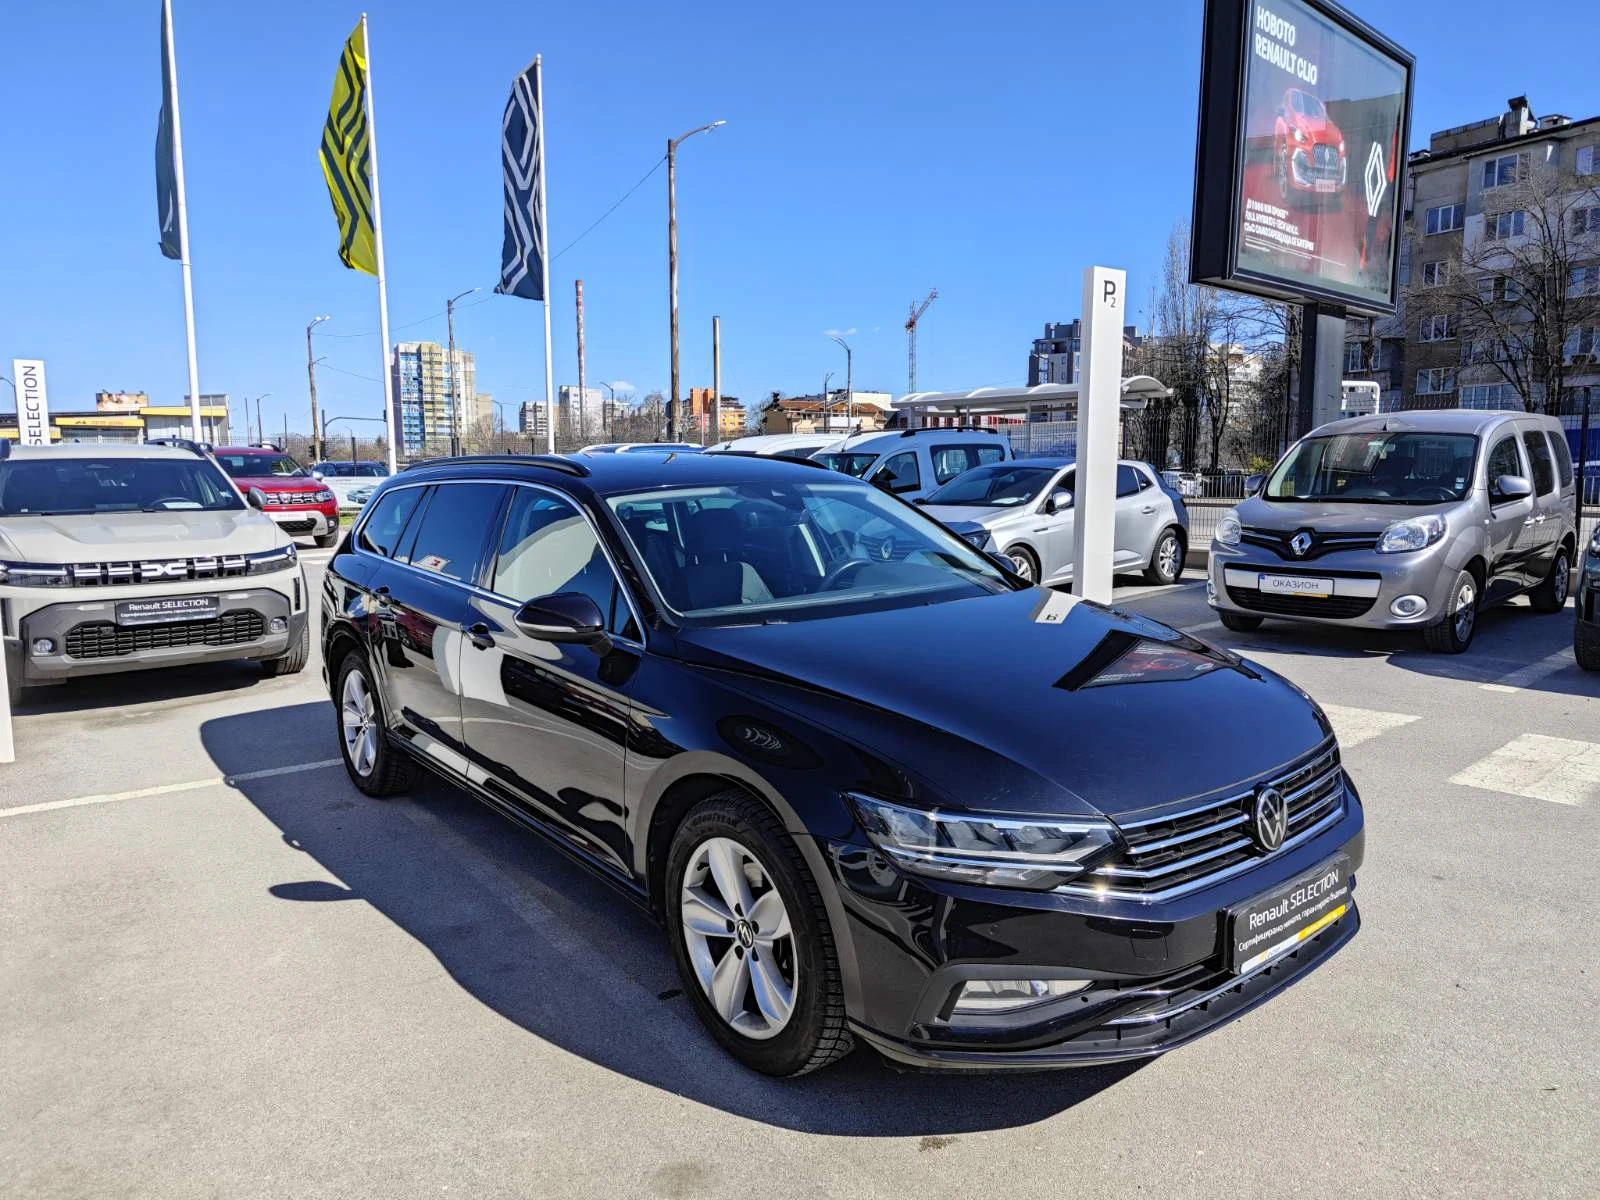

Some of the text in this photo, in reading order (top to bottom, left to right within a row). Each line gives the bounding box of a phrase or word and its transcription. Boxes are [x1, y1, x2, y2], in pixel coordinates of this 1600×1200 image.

[1256, 5, 1296, 47] НОВОТО
[1255, 32, 1317, 86] RENAULT CLIO
[128, 598, 209, 611] Renault SELECTION
[1272, 579, 1319, 590] ОКАЗИОН
[1249, 898, 1289, 930] Renault
[1290, 868, 1339, 910] SELECTION
